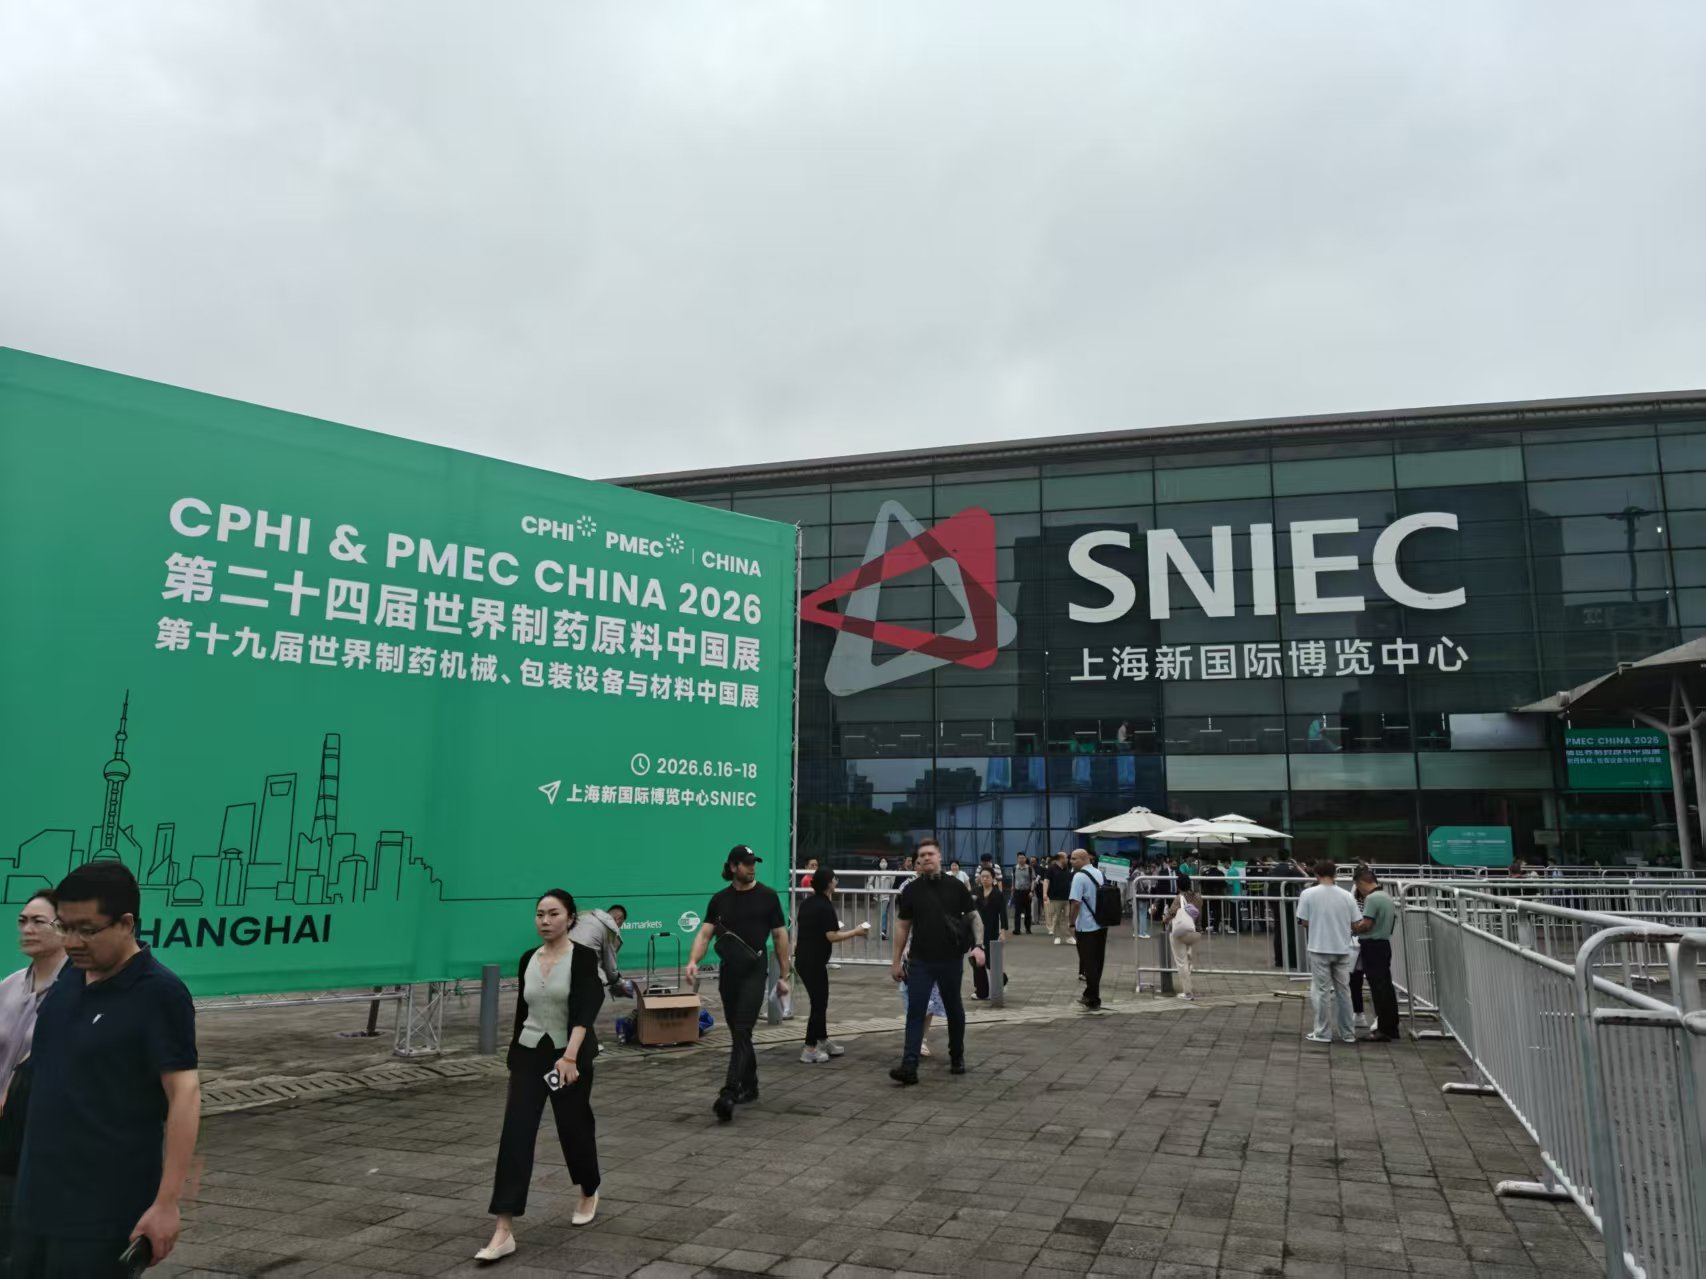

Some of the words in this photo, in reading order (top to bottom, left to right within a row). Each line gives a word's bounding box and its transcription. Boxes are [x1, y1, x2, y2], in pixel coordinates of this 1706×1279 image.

[169, 497, 311, 556] CPHI
[329, 524, 368, 565] &
[387, 532, 519, 587] PMEC
[534, 559, 667, 611] CHINA
[679, 582, 762, 626] 2026
[521, 515, 574, 542] CPHI
[605, 531, 664, 558] PMEC
[701, 550, 762, 577] CHINA
[1067, 511, 1467, 624] SNIEC
[161, 551, 762, 674] 第二十四届世界制药原料中国展
[155, 616, 760, 709] 第十九届世界制药机械、包装设备与材料中国展
[1070, 636, 1469, 681] 上海新国际博览中心
[1597, 737, 1631, 745] CHINA
[656, 757, 758, 779] 2026.6.16-18
[566, 783, 757, 808] 上海新国际博览中心SNIEC
[137, 914, 332, 949] HANGHAI
